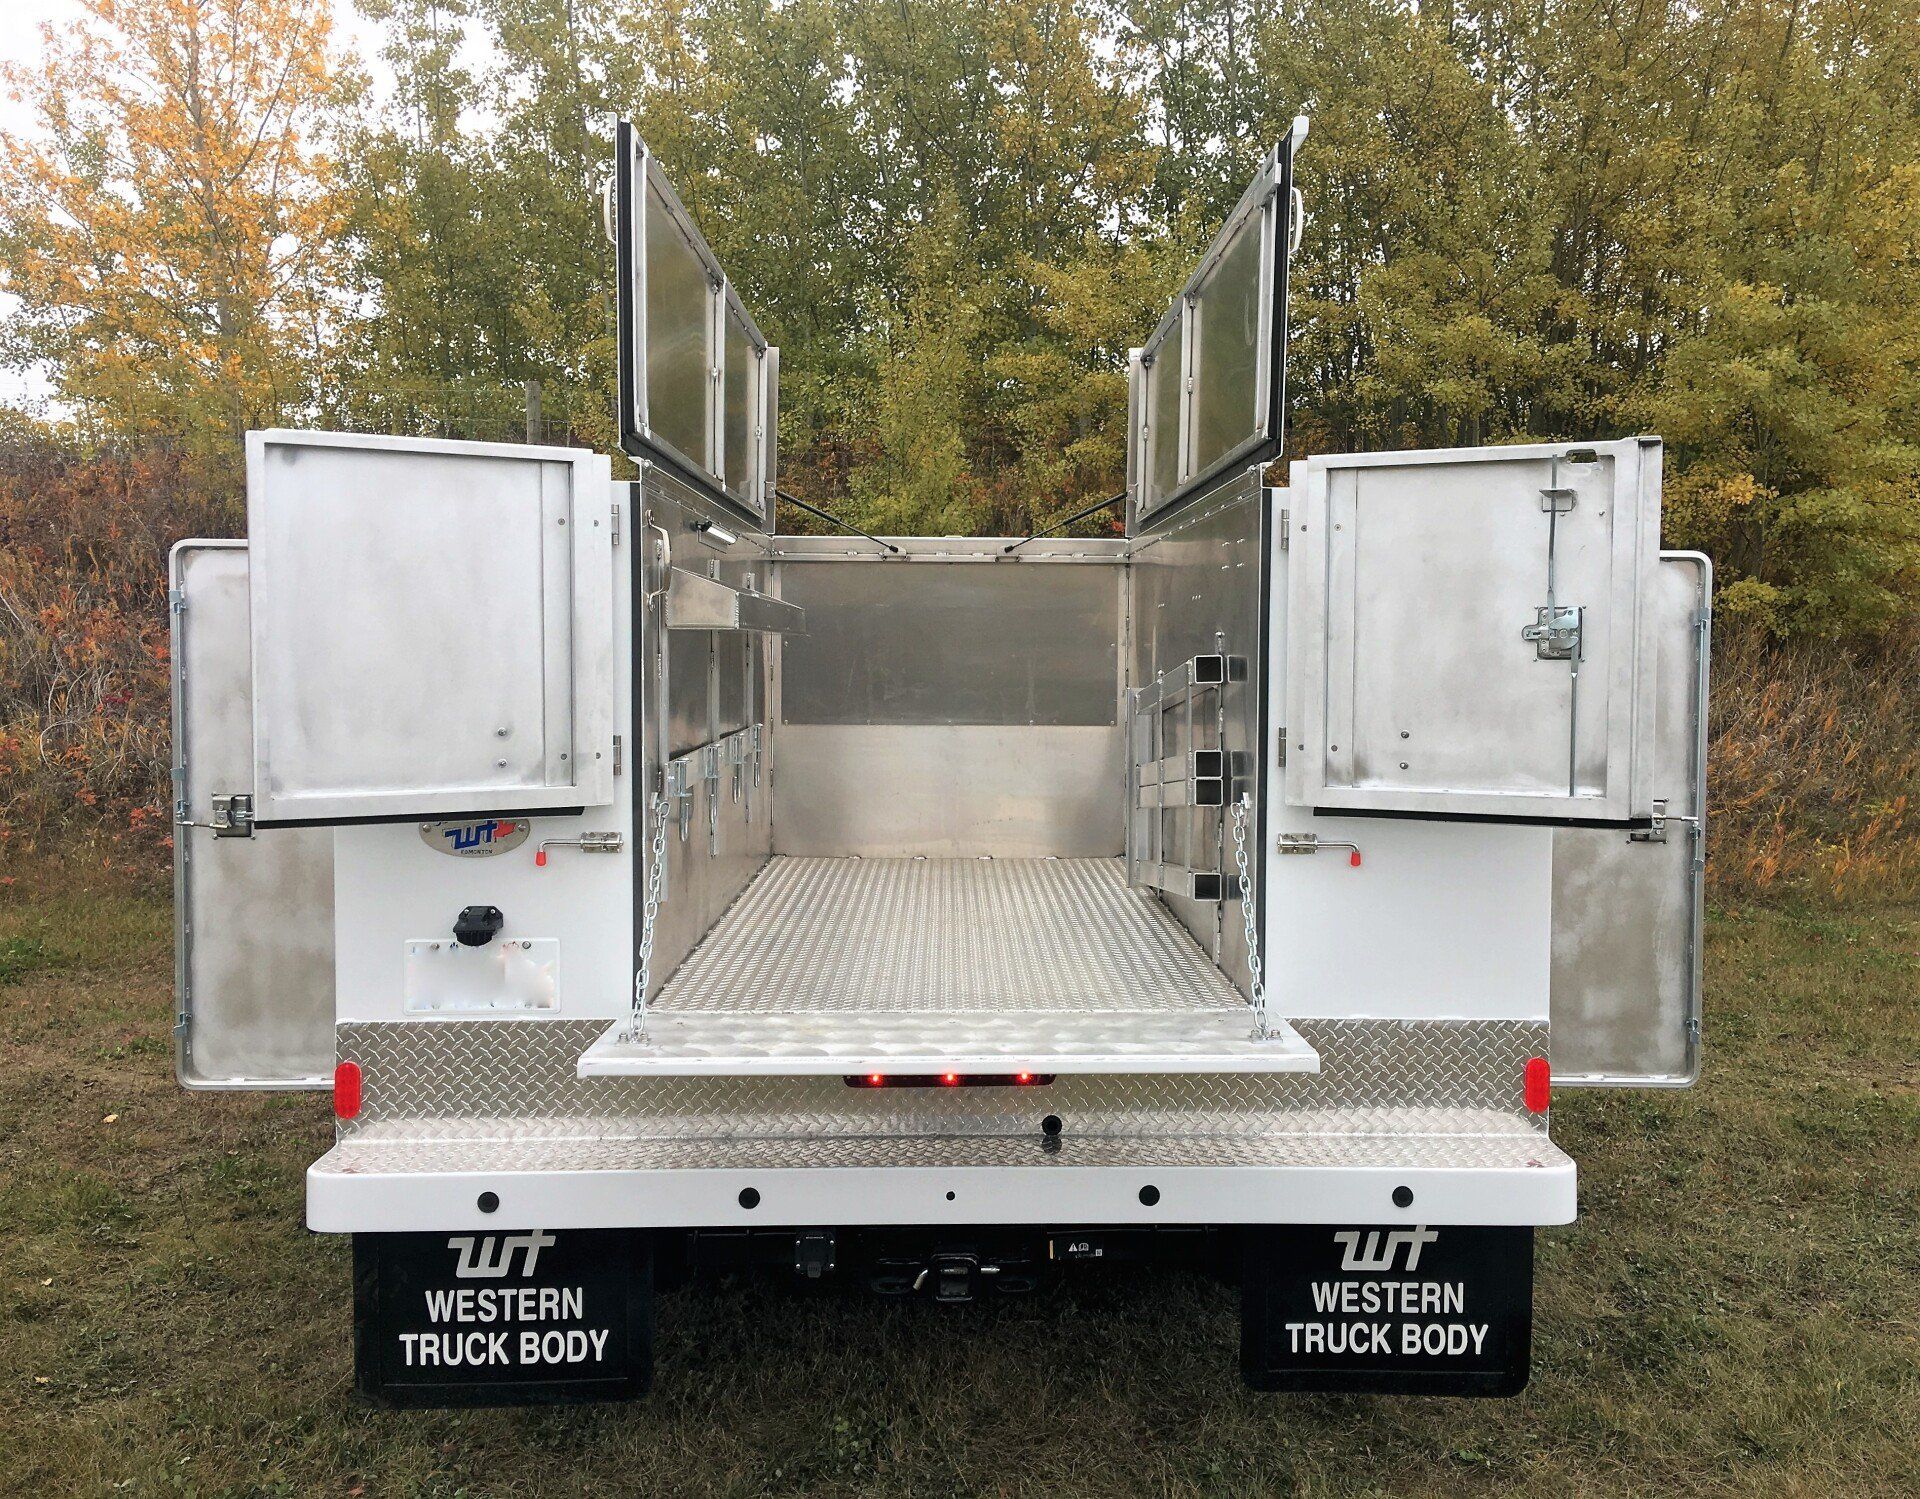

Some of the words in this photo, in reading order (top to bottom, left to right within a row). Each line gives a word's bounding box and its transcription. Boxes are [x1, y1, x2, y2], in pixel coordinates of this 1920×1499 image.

[424, 1287, 583, 1322] WESTERN
[1311, 1281, 1464, 1314] WESTERN
[398, 1332, 510, 1366] TRUCK
[520, 1329, 609, 1365] BODY
[1285, 1322, 1392, 1354] TRUCK
[1402, 1323, 1489, 1356] BODY
